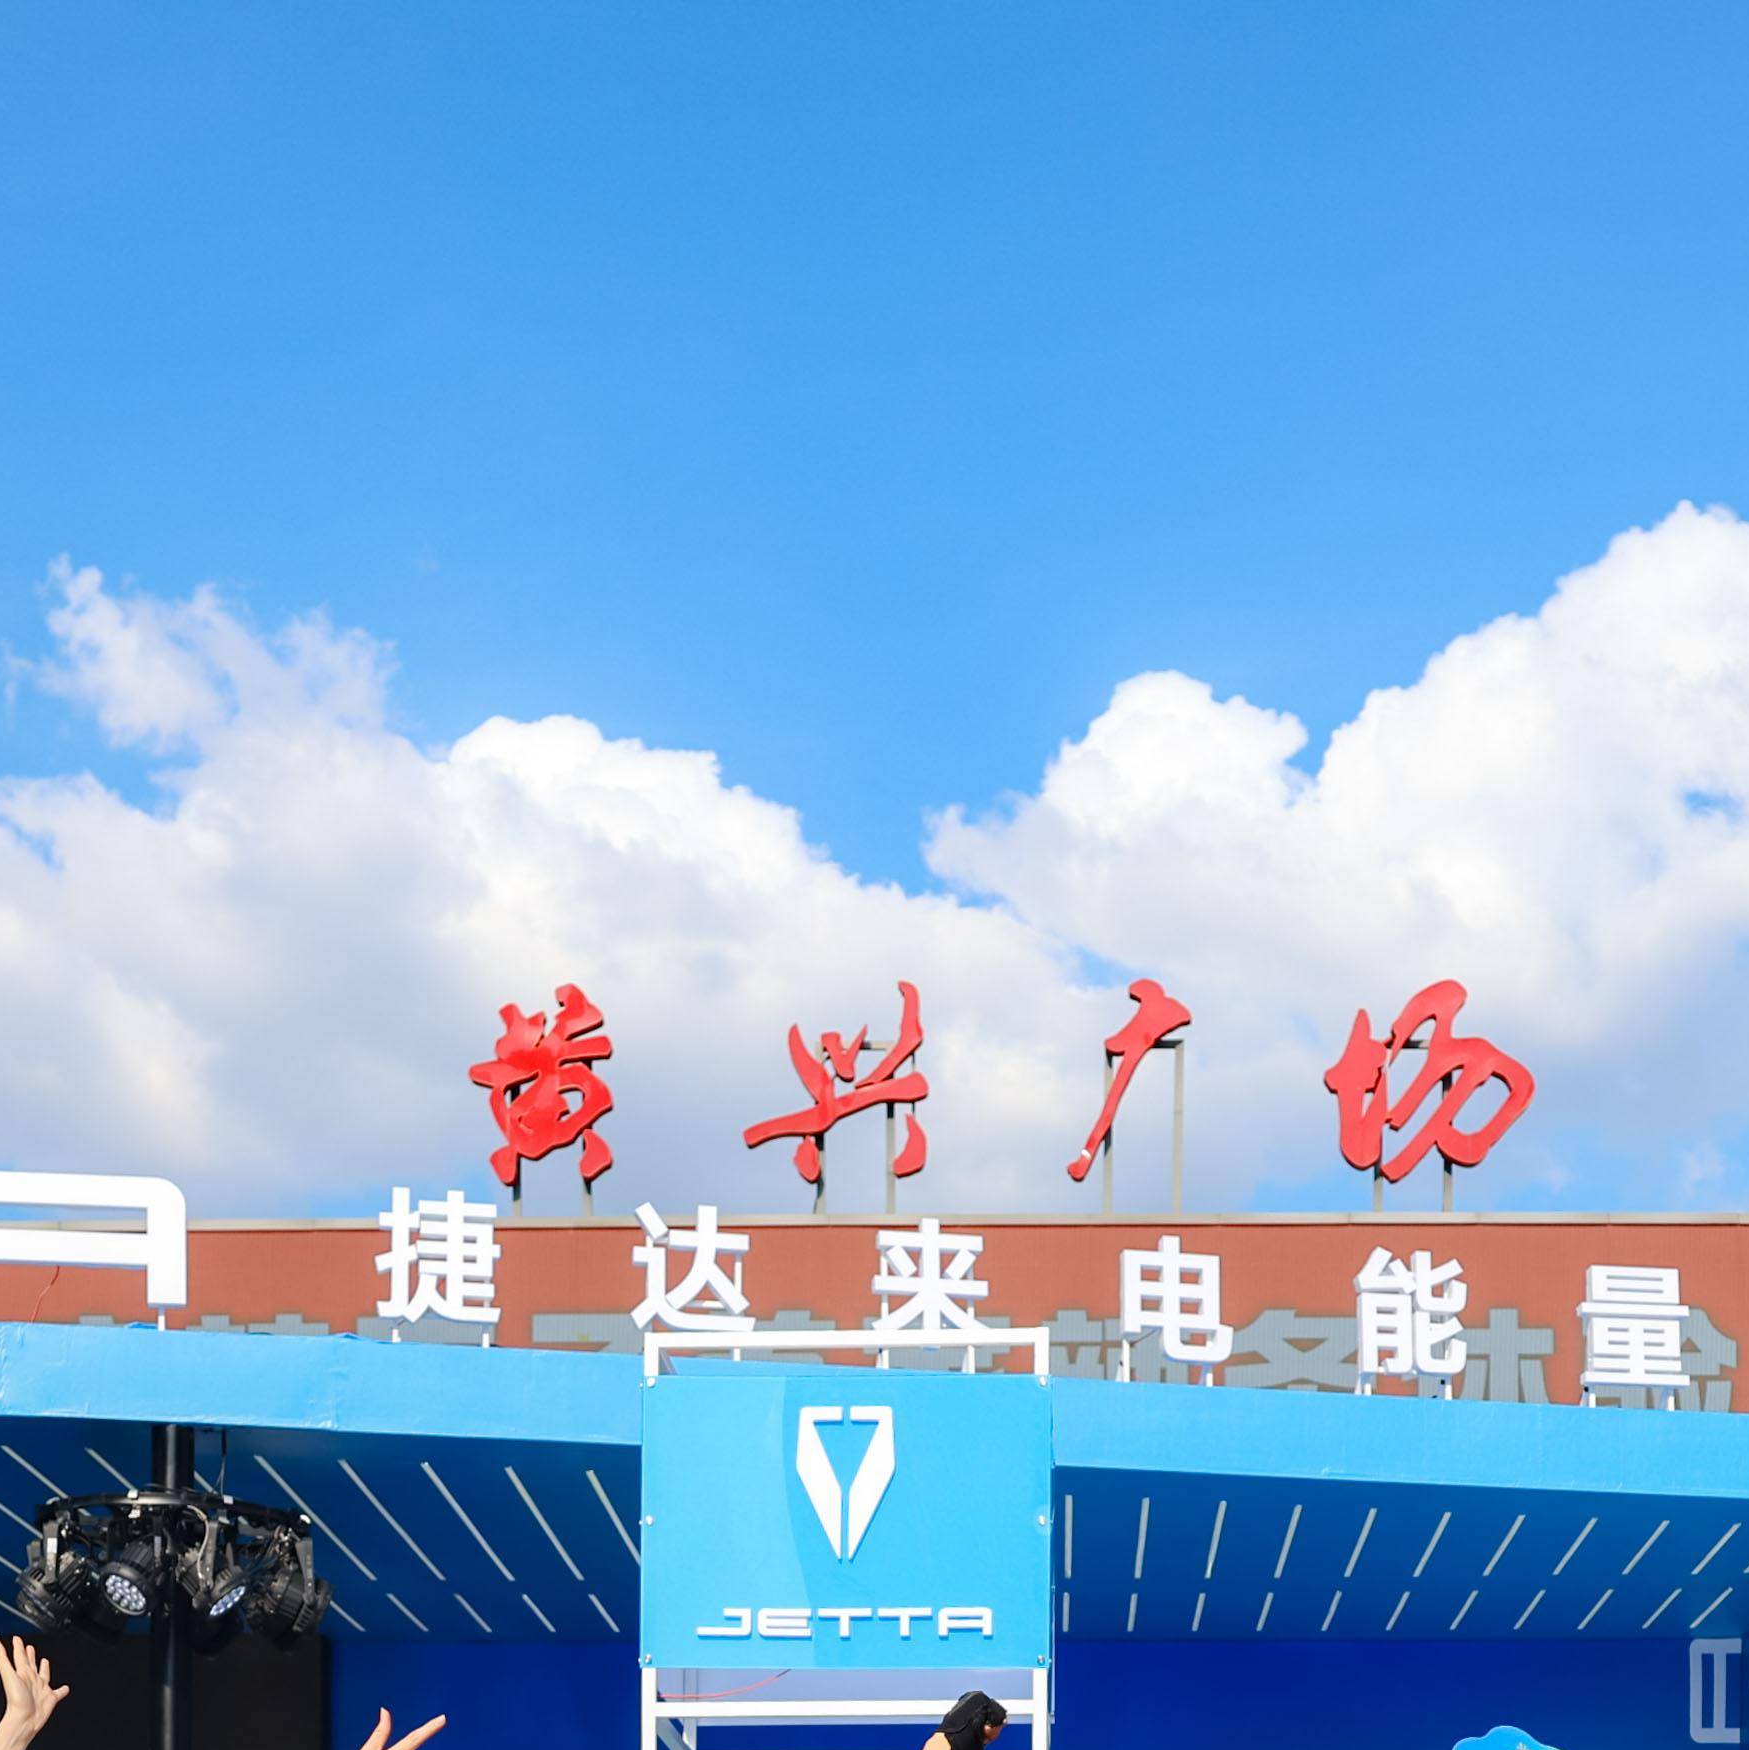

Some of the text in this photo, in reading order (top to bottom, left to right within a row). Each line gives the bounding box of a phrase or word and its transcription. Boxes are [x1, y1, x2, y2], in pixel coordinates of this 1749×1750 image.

[469, 979, 1536, 1183] 黄兴广场
[696, 1606, 994, 1638] JETTA
